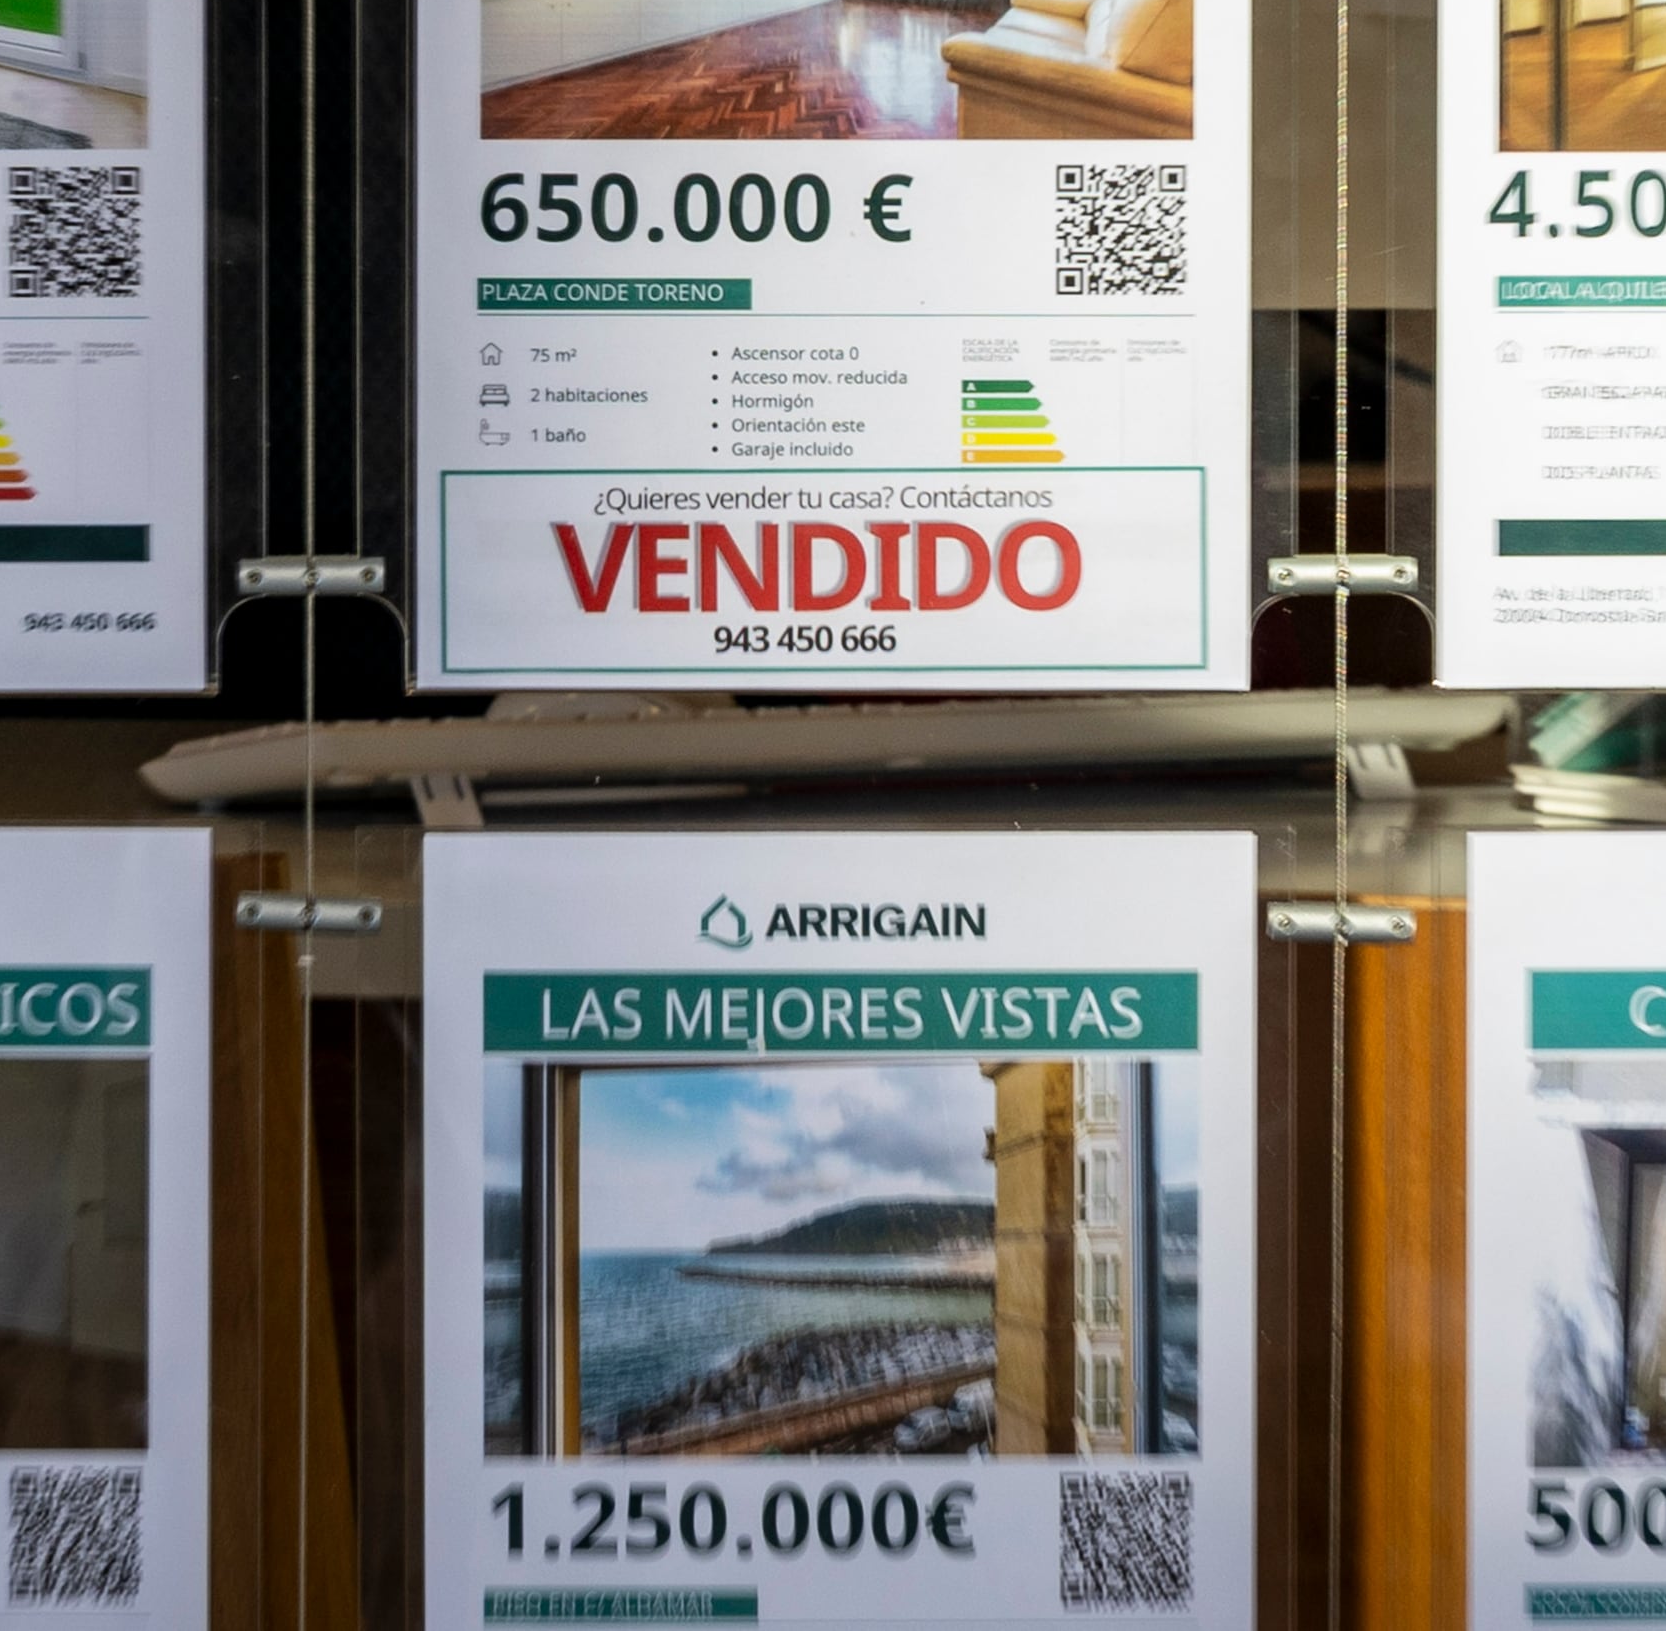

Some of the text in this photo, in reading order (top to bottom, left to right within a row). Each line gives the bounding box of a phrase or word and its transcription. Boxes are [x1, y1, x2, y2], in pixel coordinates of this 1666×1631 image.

[479, 171, 915, 244] 650.000 €
[481, 282, 725, 304] PLAZA CONDE TORENO
[530, 347, 578, 363] 75 m²
[731, 346, 860, 361] Ascensor cota 0
[731, 370, 908, 385] Acceso mov. reducida
[966, 382, 977, 392] A
[530, 387, 649, 403] 2 habitaciones
[731, 393, 814, 412] Hormigón
[966, 399, 977, 409] B
[731, 417, 866, 433] Orientación este
[966, 416, 977, 427] C
[530, 427, 587, 443] 1 baño
[731, 441, 854, 460] Garaje incluido
[593, 483, 1054, 516] ¿Quieres vender tu casa? Contáctanos
[551, 519, 1085, 614] VENDIDO
[713, 624, 897, 655] 943 450 666
[765, 902, 988, 942] ARRIGAIN
[541, 985, 1144, 1056] LAS MEJORES VISTAS
[489, 1479, 978, 1561] 1.250.000€
